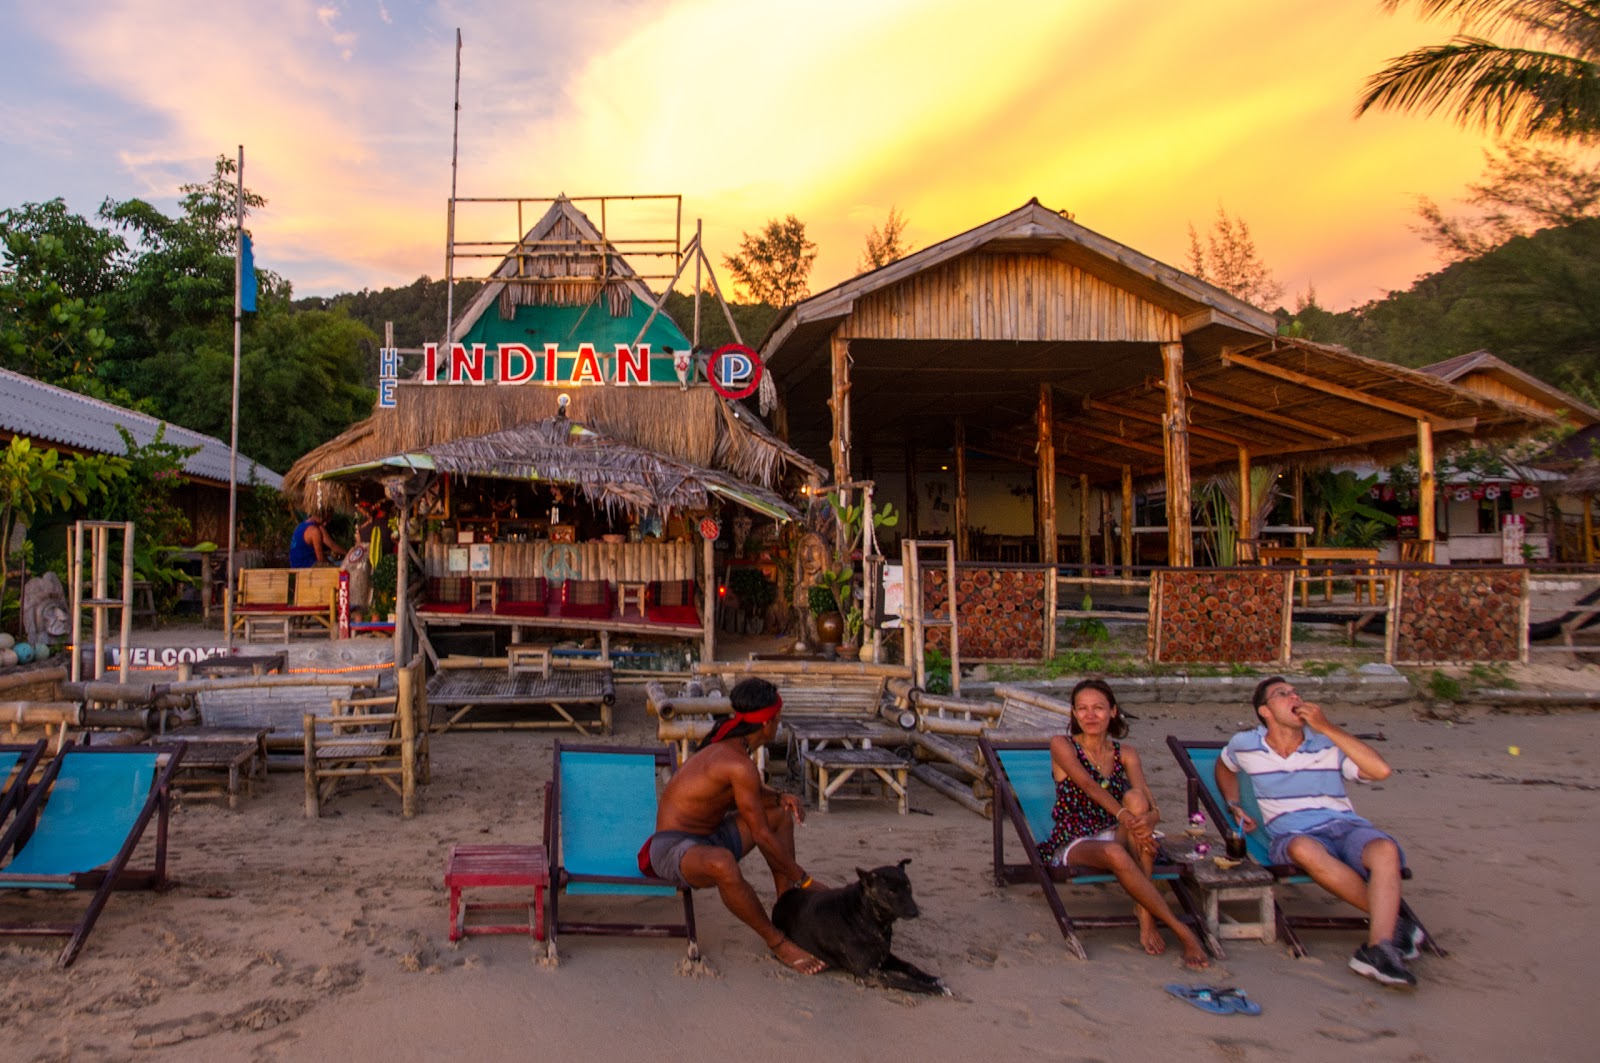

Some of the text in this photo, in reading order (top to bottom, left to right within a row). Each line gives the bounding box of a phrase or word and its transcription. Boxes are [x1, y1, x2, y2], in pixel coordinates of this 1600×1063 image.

[379, 347, 398, 408] HE
[422, 342, 652, 386] INDIAN
[721, 353, 753, 386] P
[339, 580, 348, 628] INDIAN
